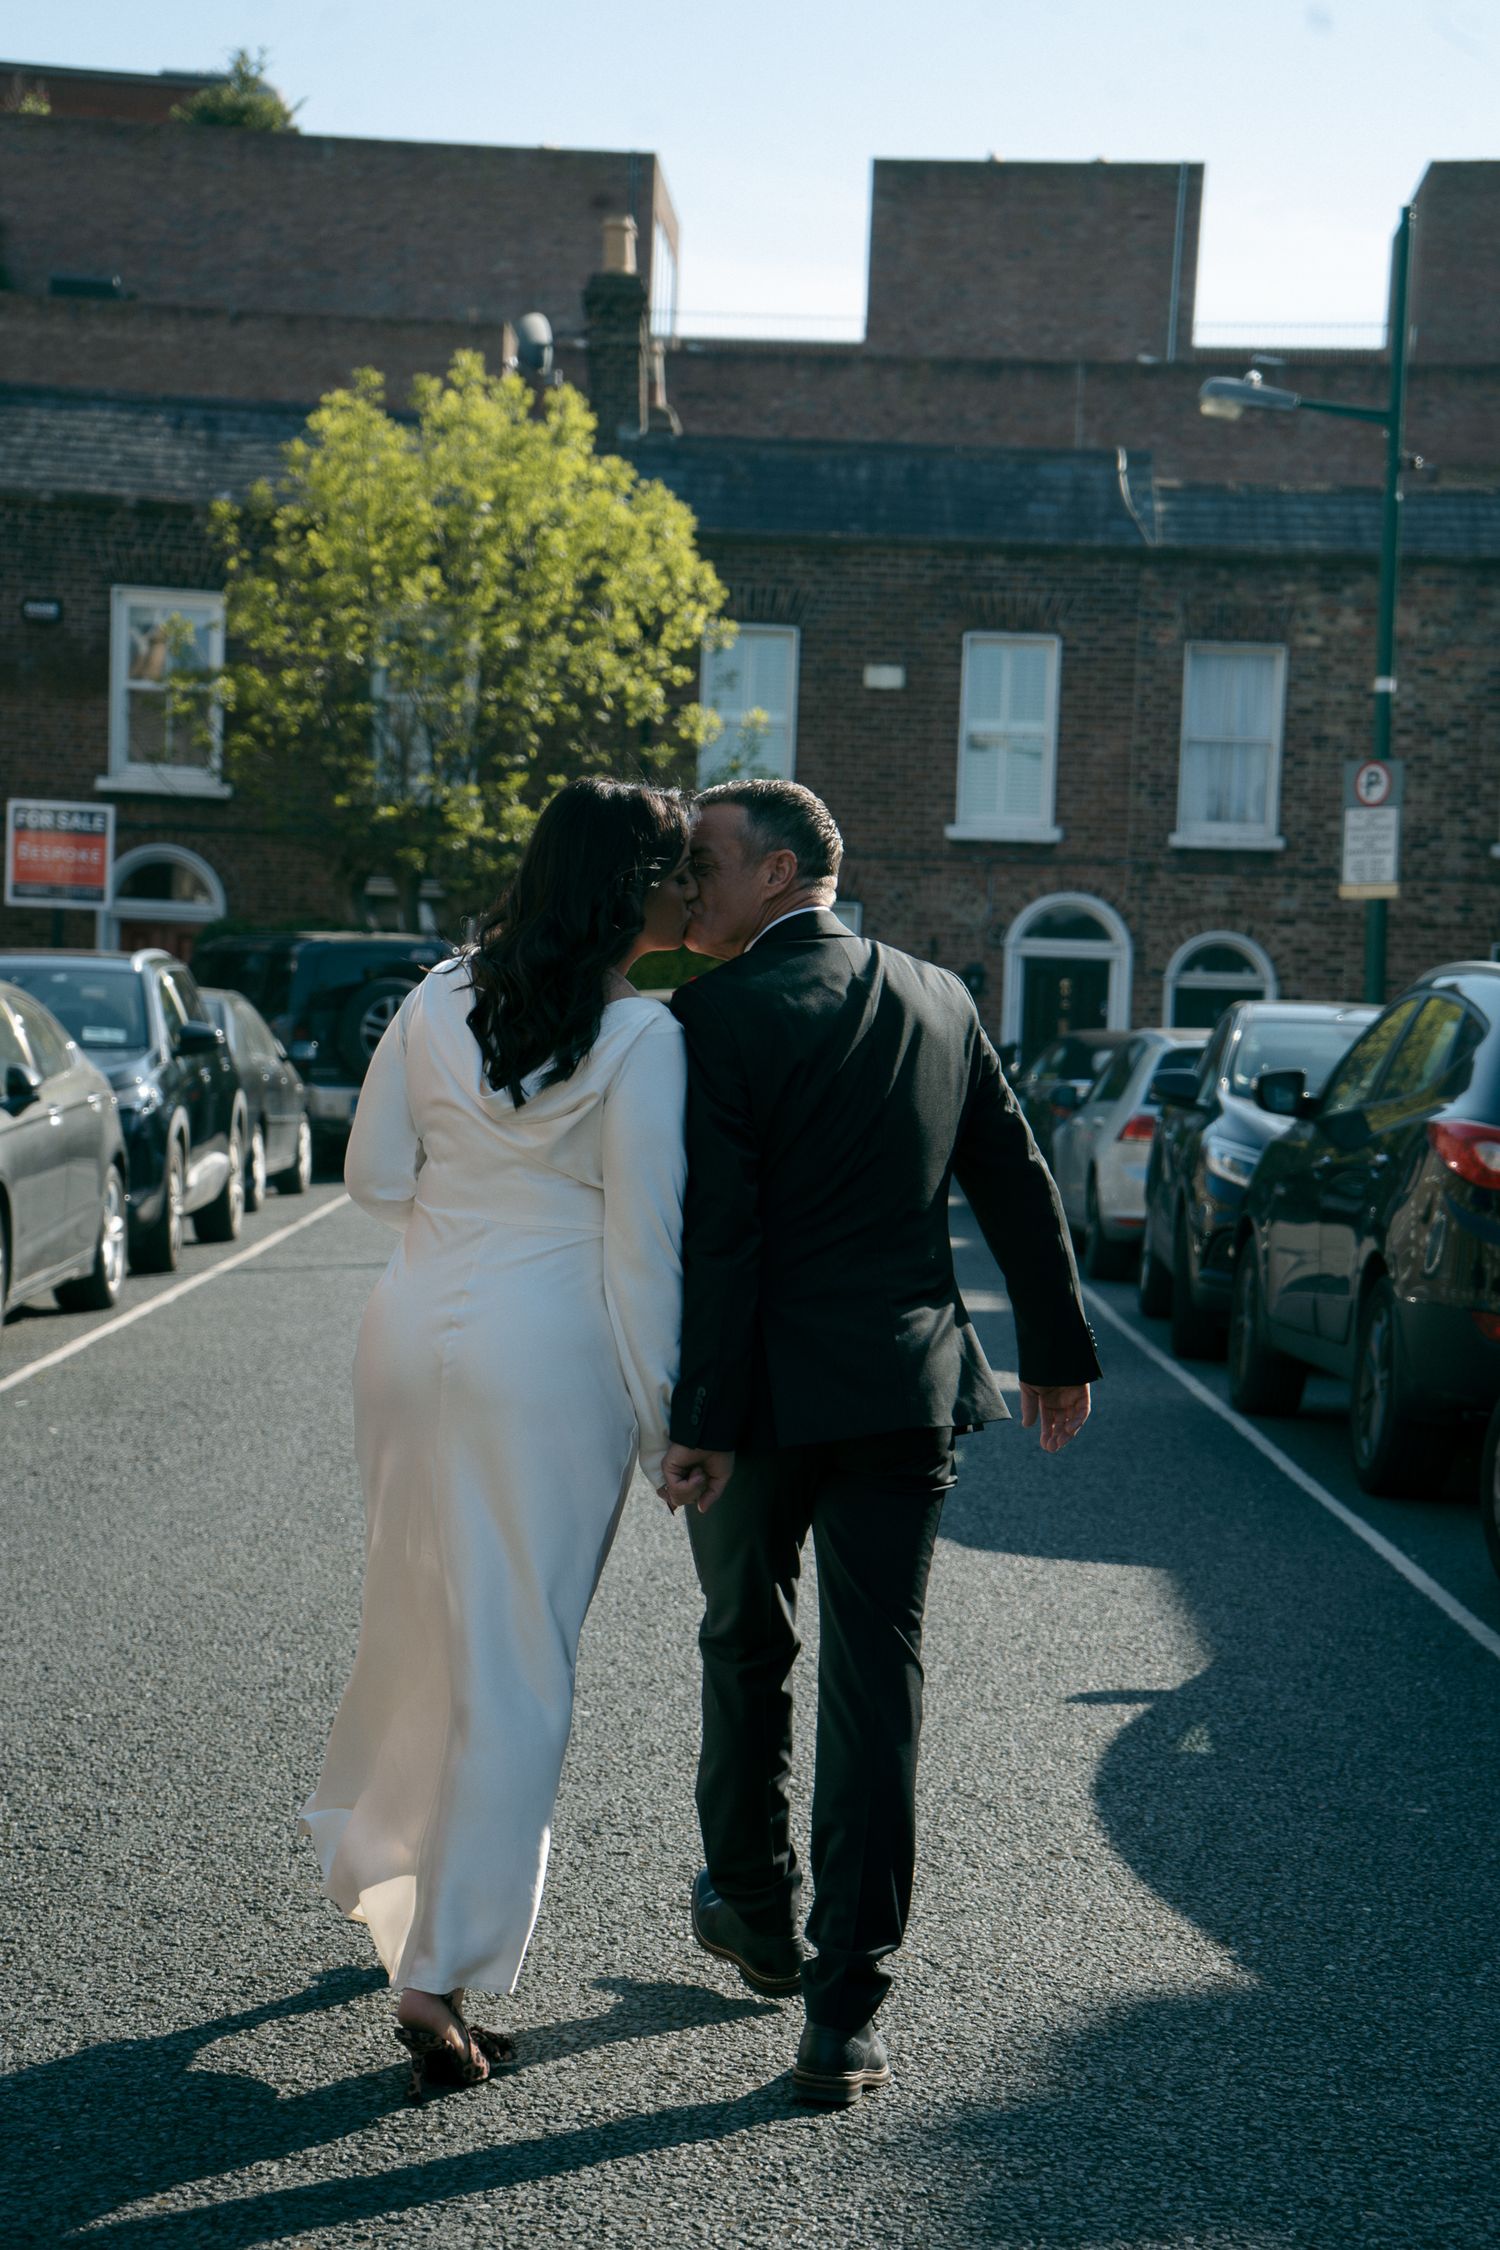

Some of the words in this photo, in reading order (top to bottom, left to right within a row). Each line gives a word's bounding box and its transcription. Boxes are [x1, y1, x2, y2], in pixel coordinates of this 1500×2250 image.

[1365, 771, 1381, 797] P
[16, 809, 54, 829] FOR
[57, 811, 105, 832] SALE
